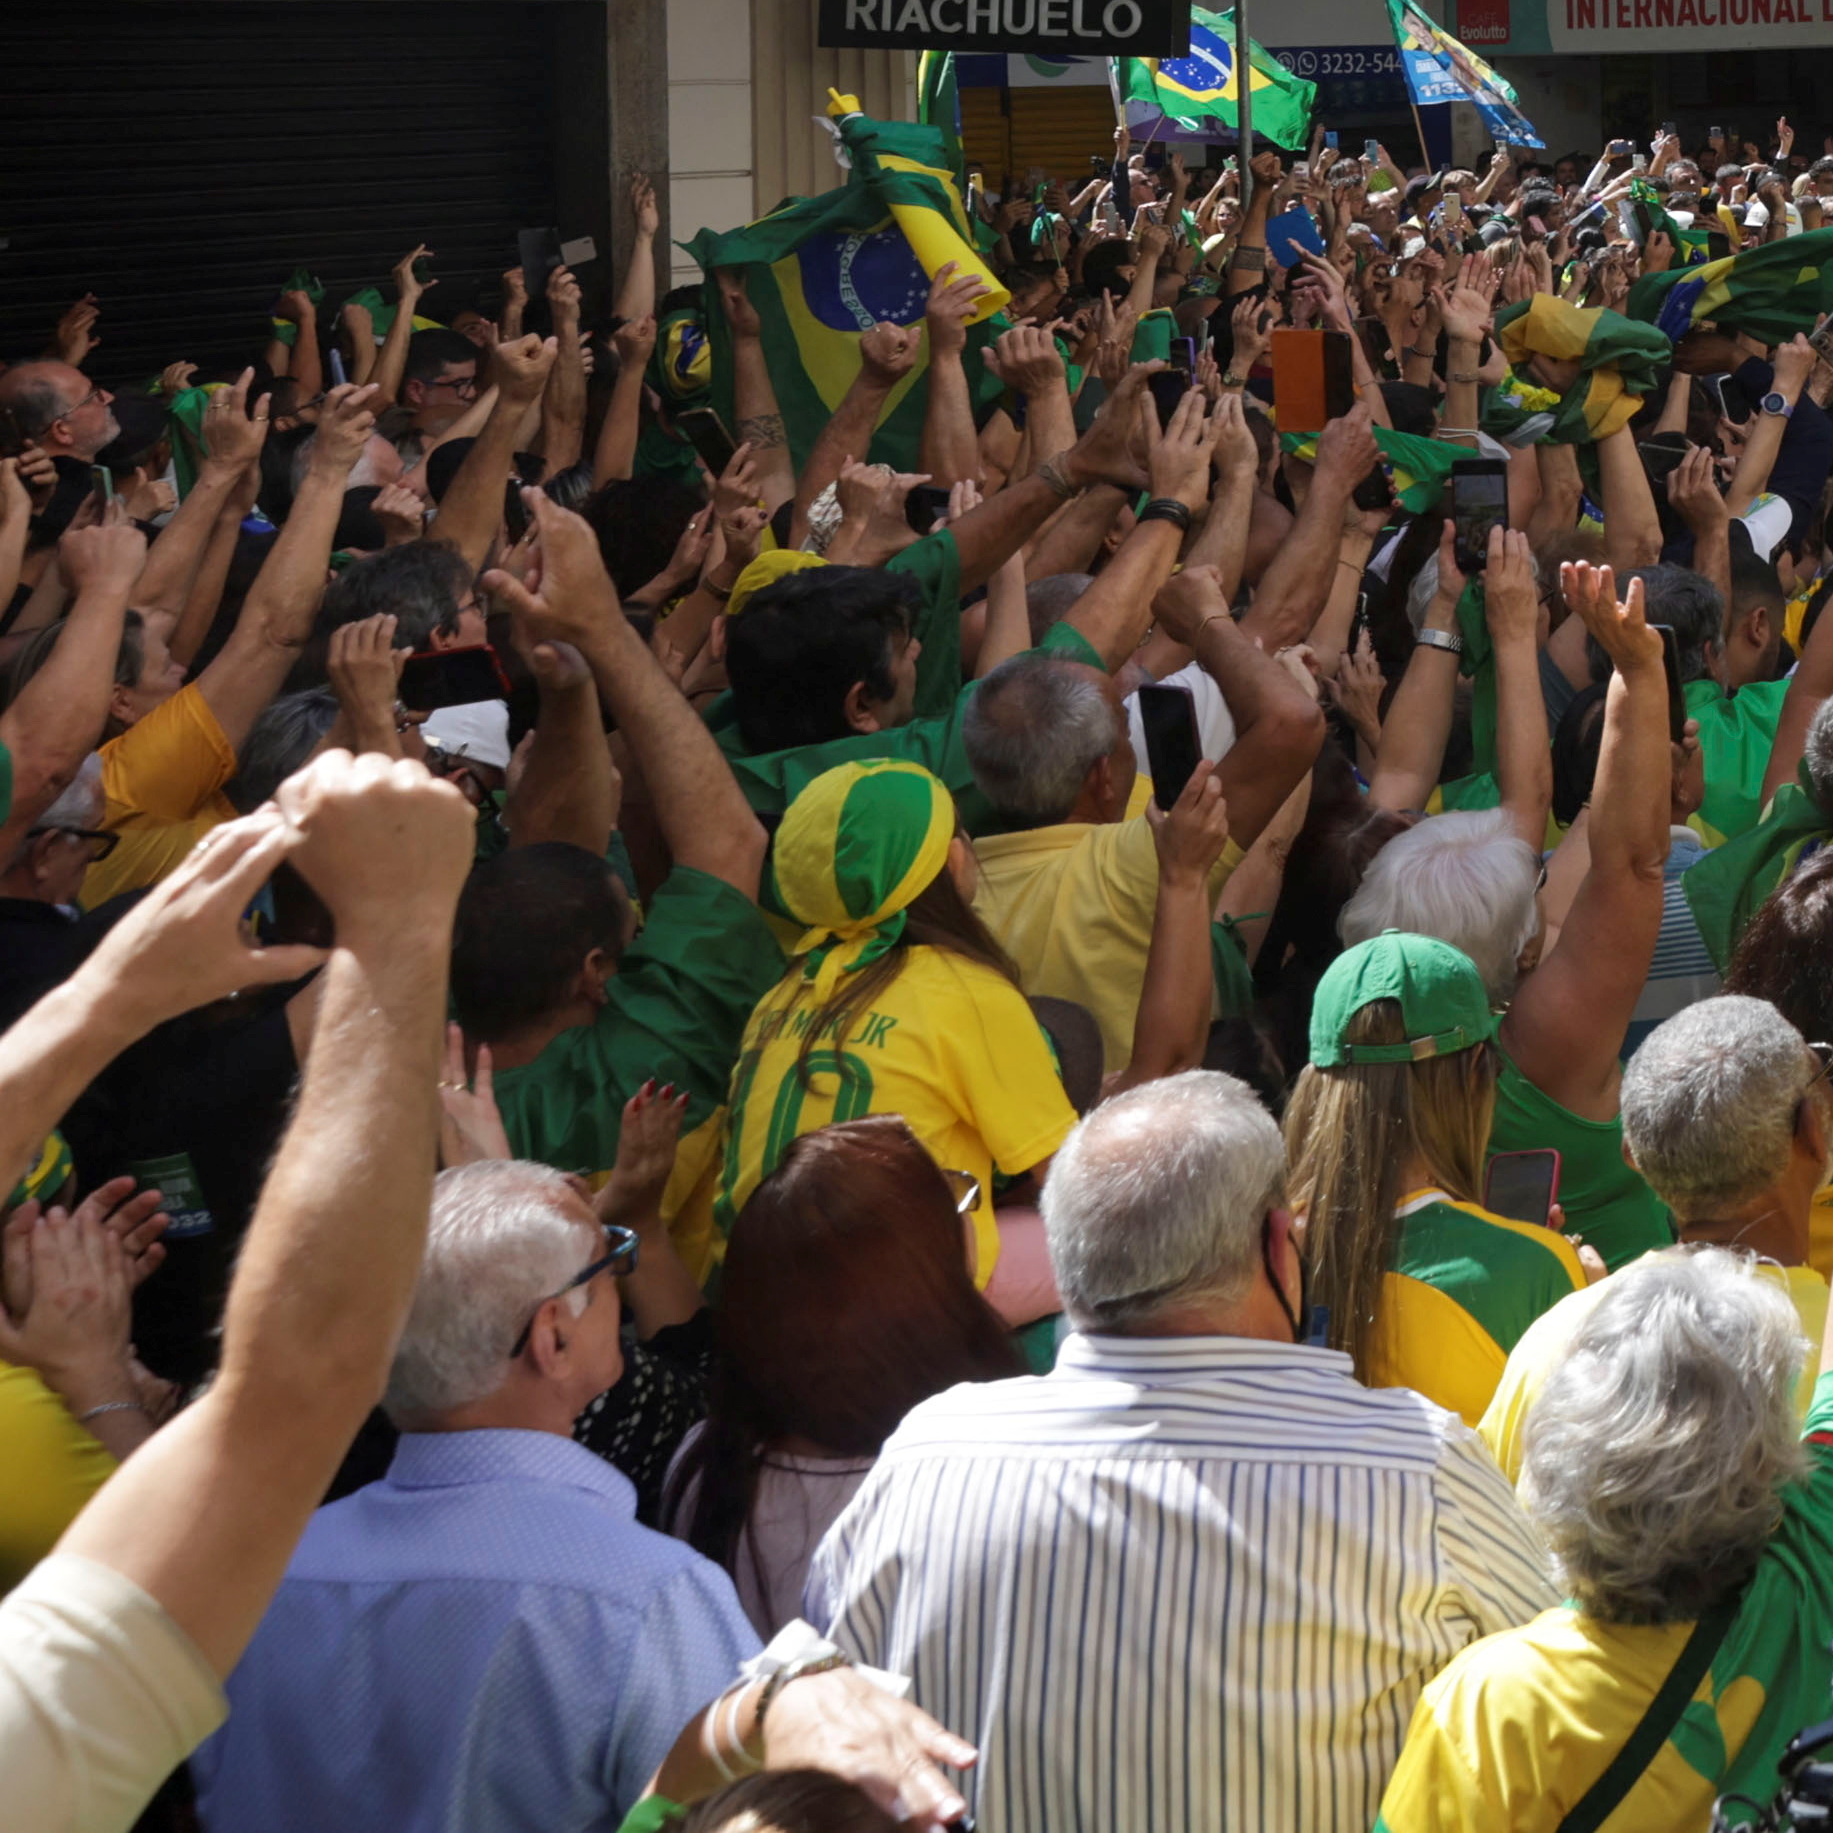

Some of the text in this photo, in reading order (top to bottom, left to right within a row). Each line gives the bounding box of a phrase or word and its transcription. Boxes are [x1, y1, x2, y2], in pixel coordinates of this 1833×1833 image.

[1460, 25, 1507, 41] Evolutto
[1321, 53, 1403, 74] 3232-544
[849, 1011, 899, 1049] JR
